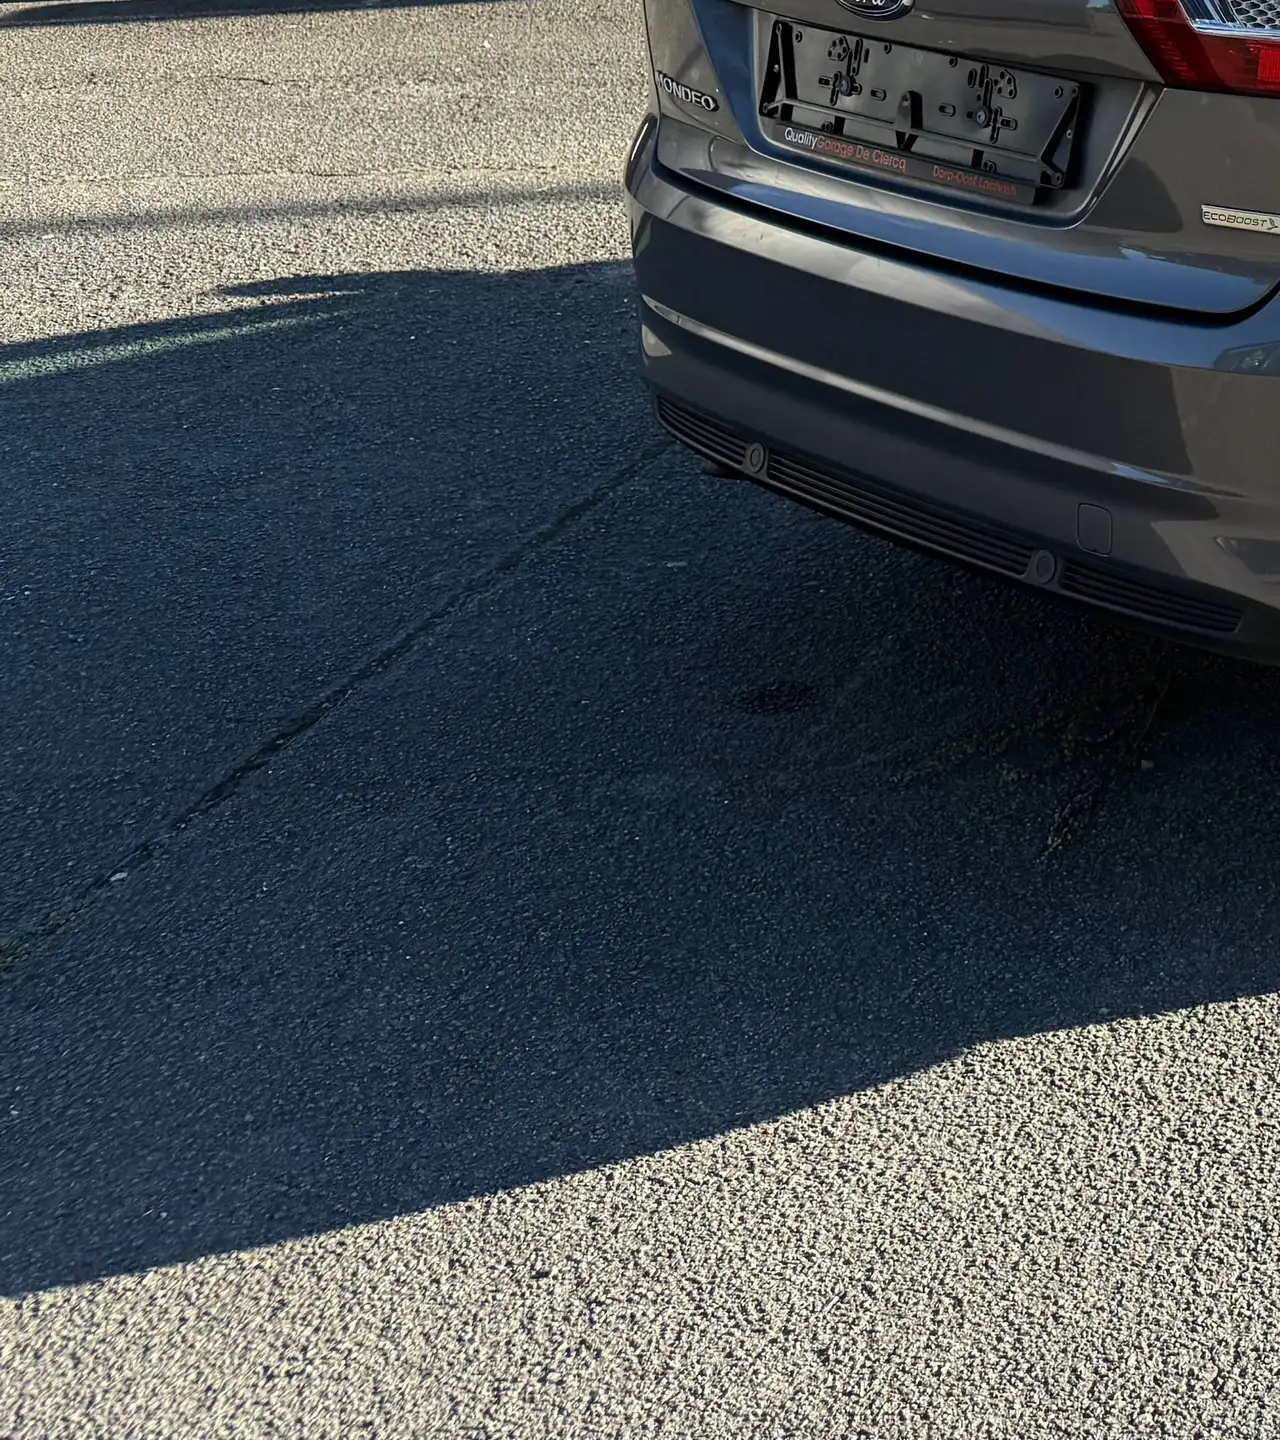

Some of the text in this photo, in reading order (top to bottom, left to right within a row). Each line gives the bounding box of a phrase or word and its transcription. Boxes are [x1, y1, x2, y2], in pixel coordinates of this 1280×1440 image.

[655, 71, 715, 111] MONDEO
[856, 145, 870, 159] De
[1203, 211, 1267, 227] ECOBOOST
